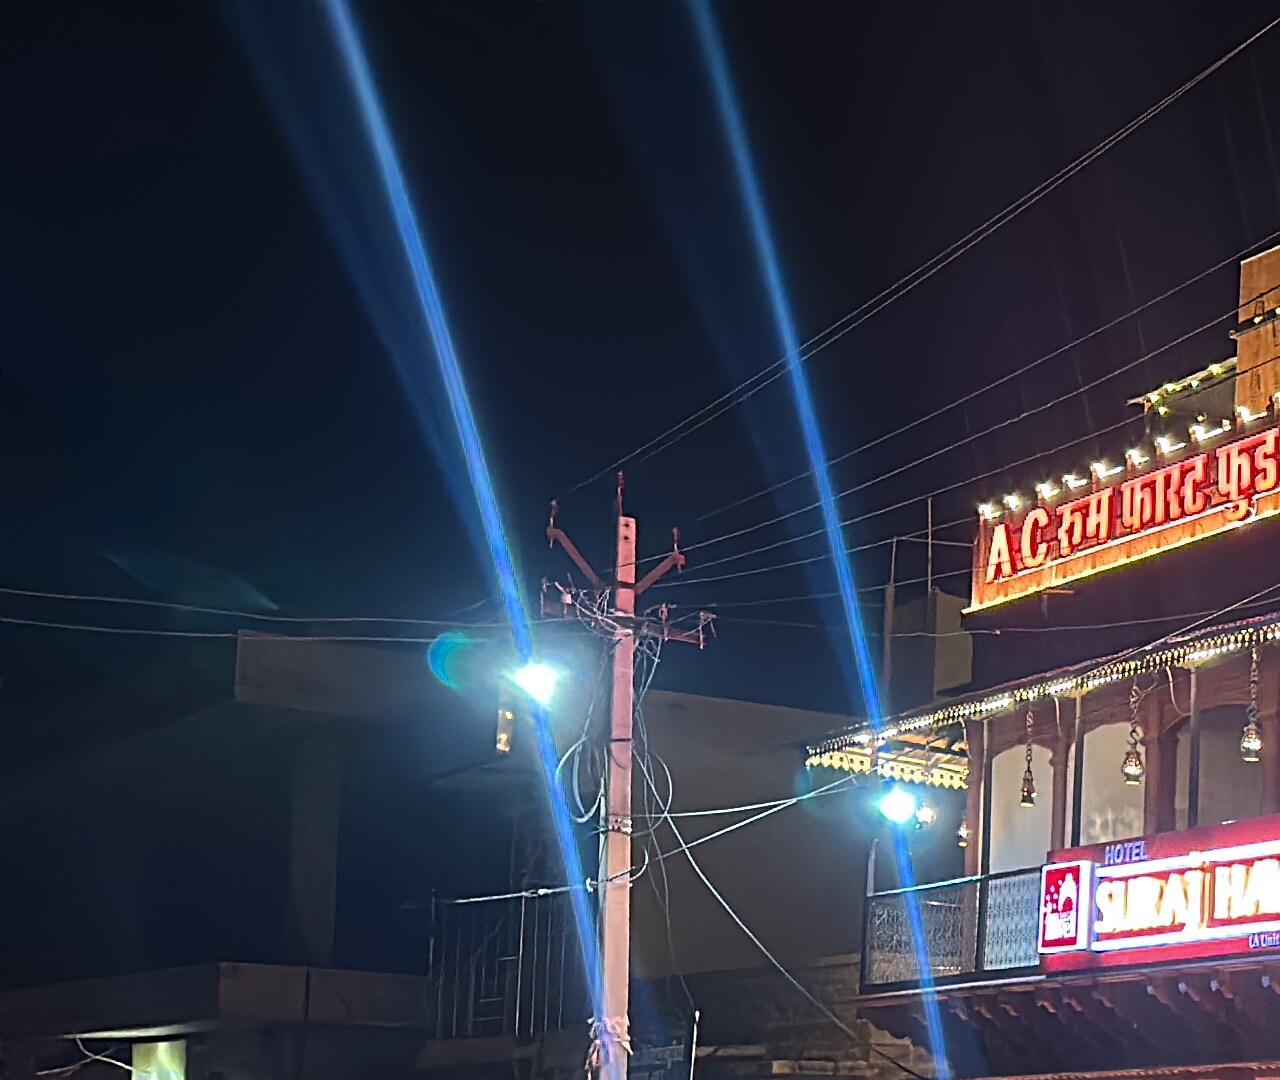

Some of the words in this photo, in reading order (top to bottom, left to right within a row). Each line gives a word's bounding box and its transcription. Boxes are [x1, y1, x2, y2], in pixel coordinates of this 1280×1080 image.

[985, 523, 1016, 583] A
[1020, 506, 1049, 569] C
[1104, 841, 1149, 865] HOTEL
[1093, 870, 1212, 934] SURAJ
[1261, 932, 1280, 947] Unit
